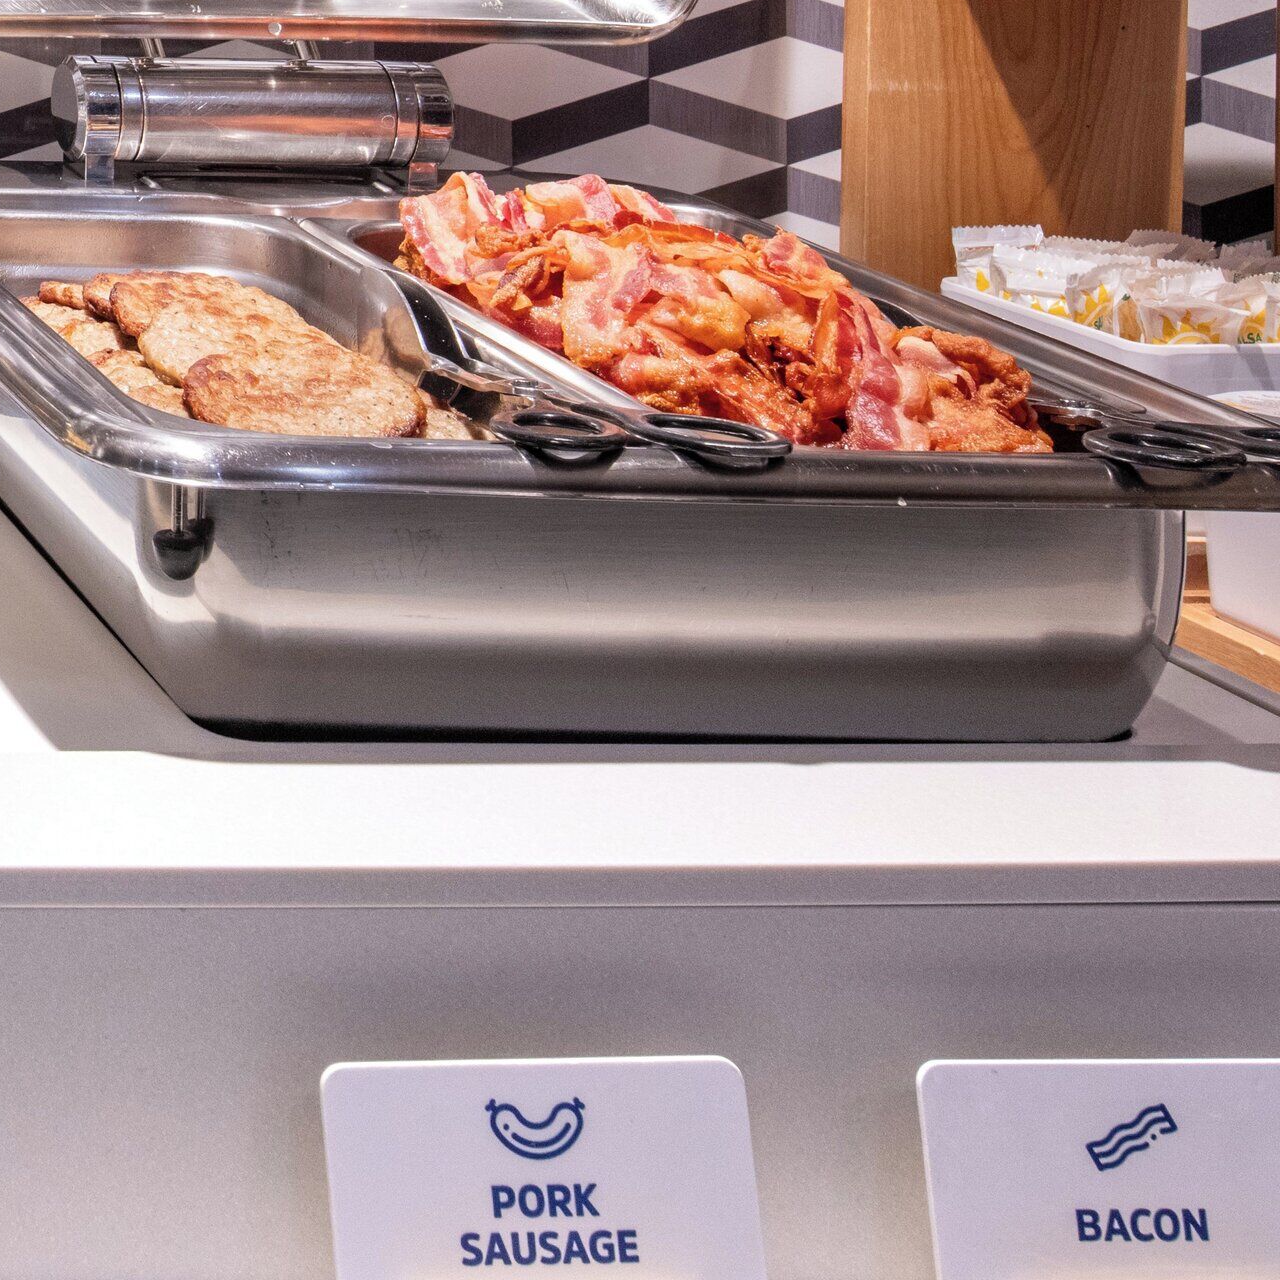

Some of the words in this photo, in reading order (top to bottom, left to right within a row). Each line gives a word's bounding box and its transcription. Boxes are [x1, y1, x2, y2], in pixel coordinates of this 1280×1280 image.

[491, 1183, 600, 1219] PORK
[1075, 1207, 1210, 1242] BACON
[460, 1229, 640, 1266] SAUSAGE
